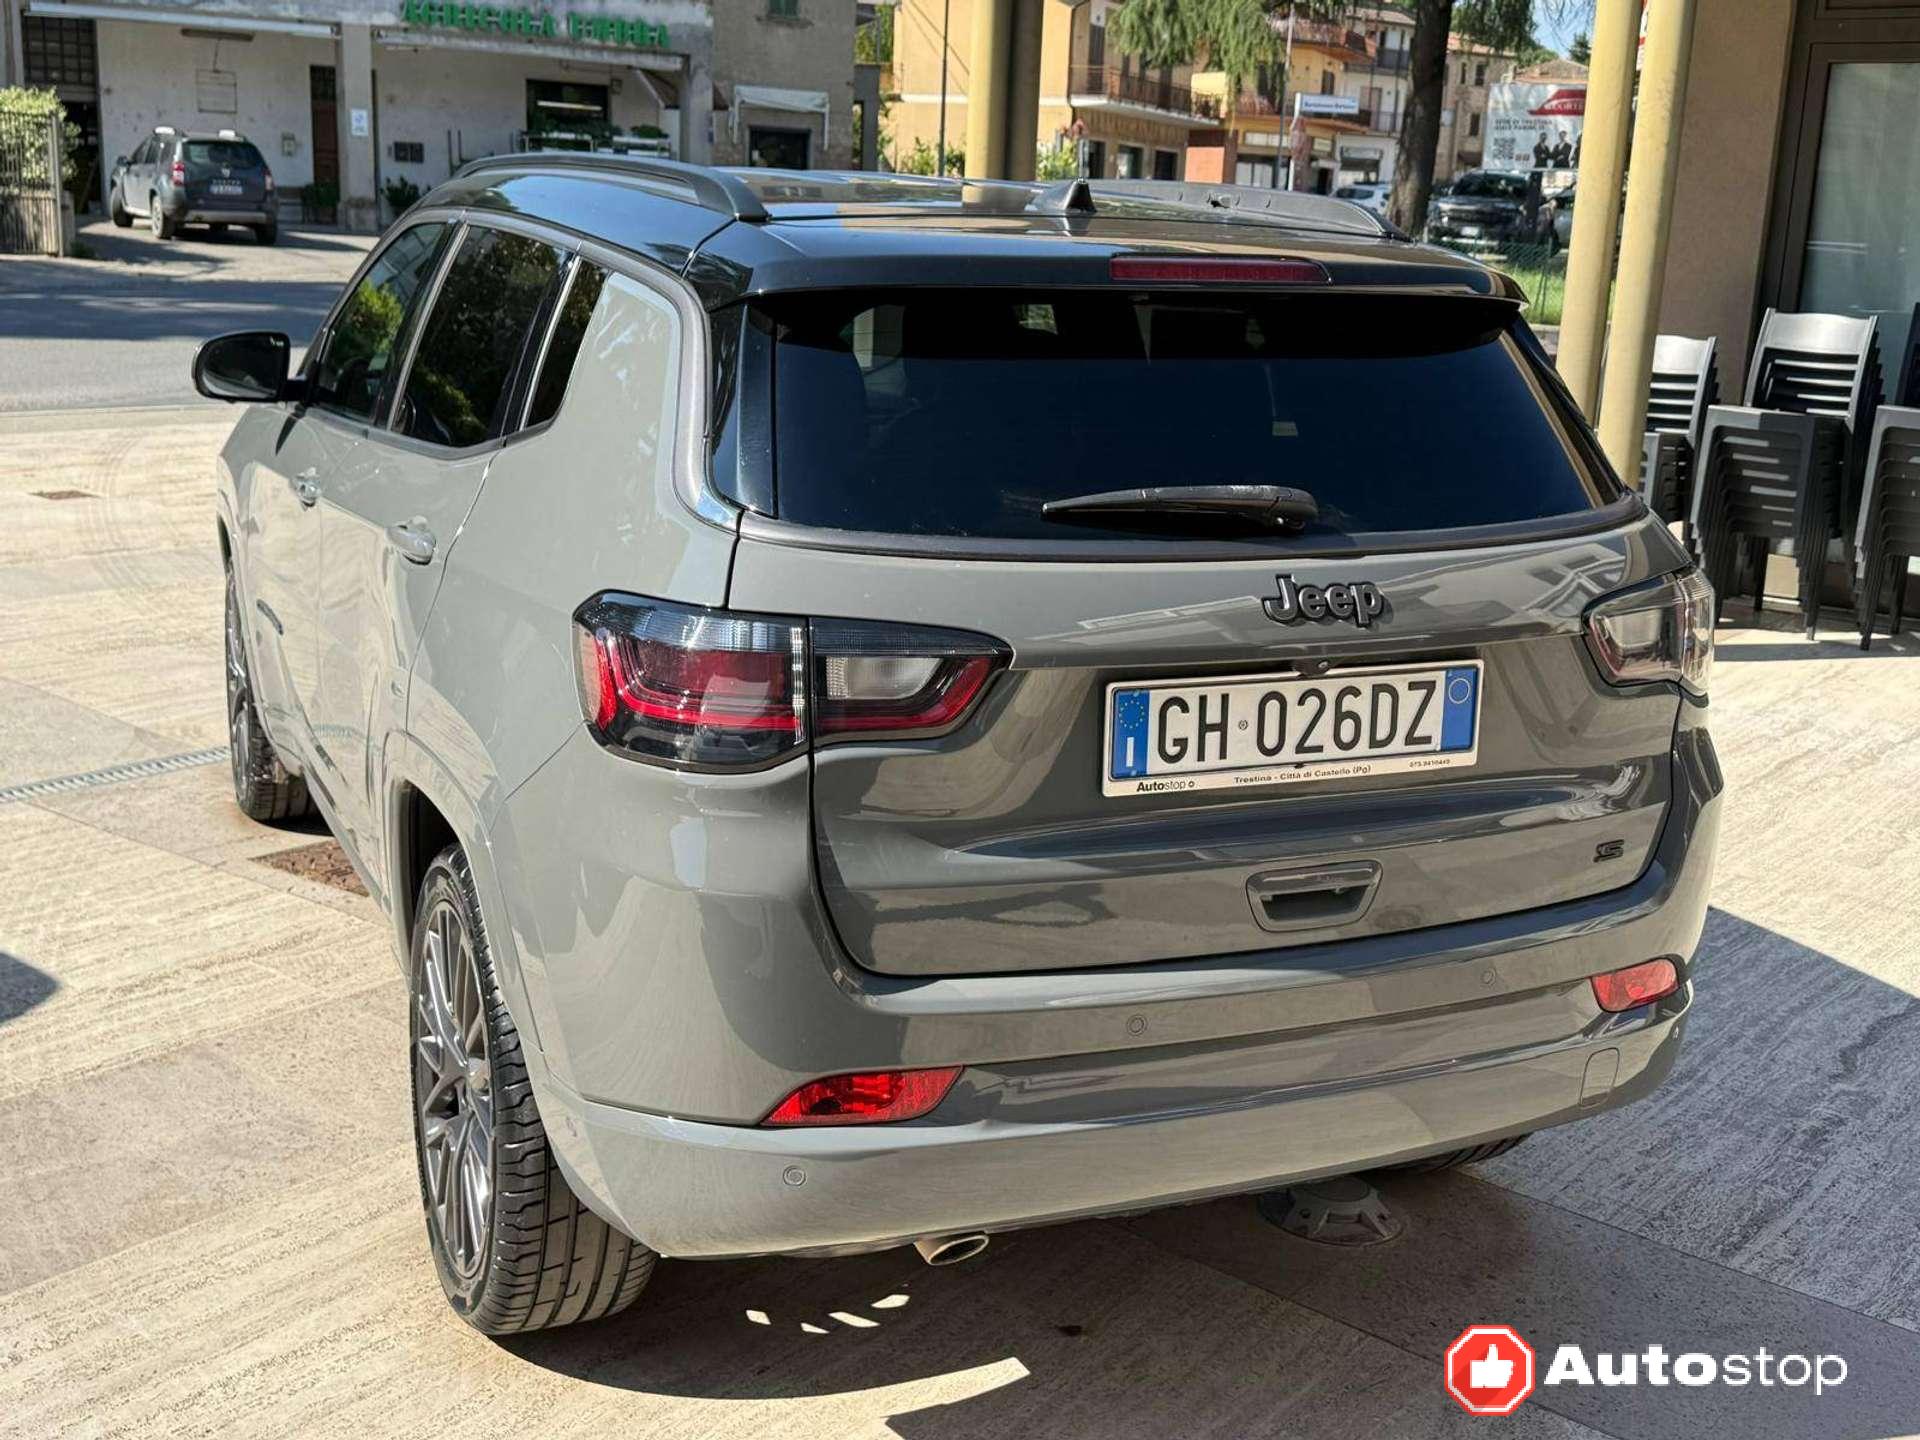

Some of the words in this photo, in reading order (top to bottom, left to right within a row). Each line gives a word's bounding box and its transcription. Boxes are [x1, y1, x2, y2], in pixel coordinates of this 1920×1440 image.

[1261, 572, 1385, 628] Jeep
[1157, 692, 1230, 764] GH
[1256, 680, 1437, 757] 026DZ
[1137, 779, 1186, 792] Autostop
[1303, 771, 1312, 779] di
